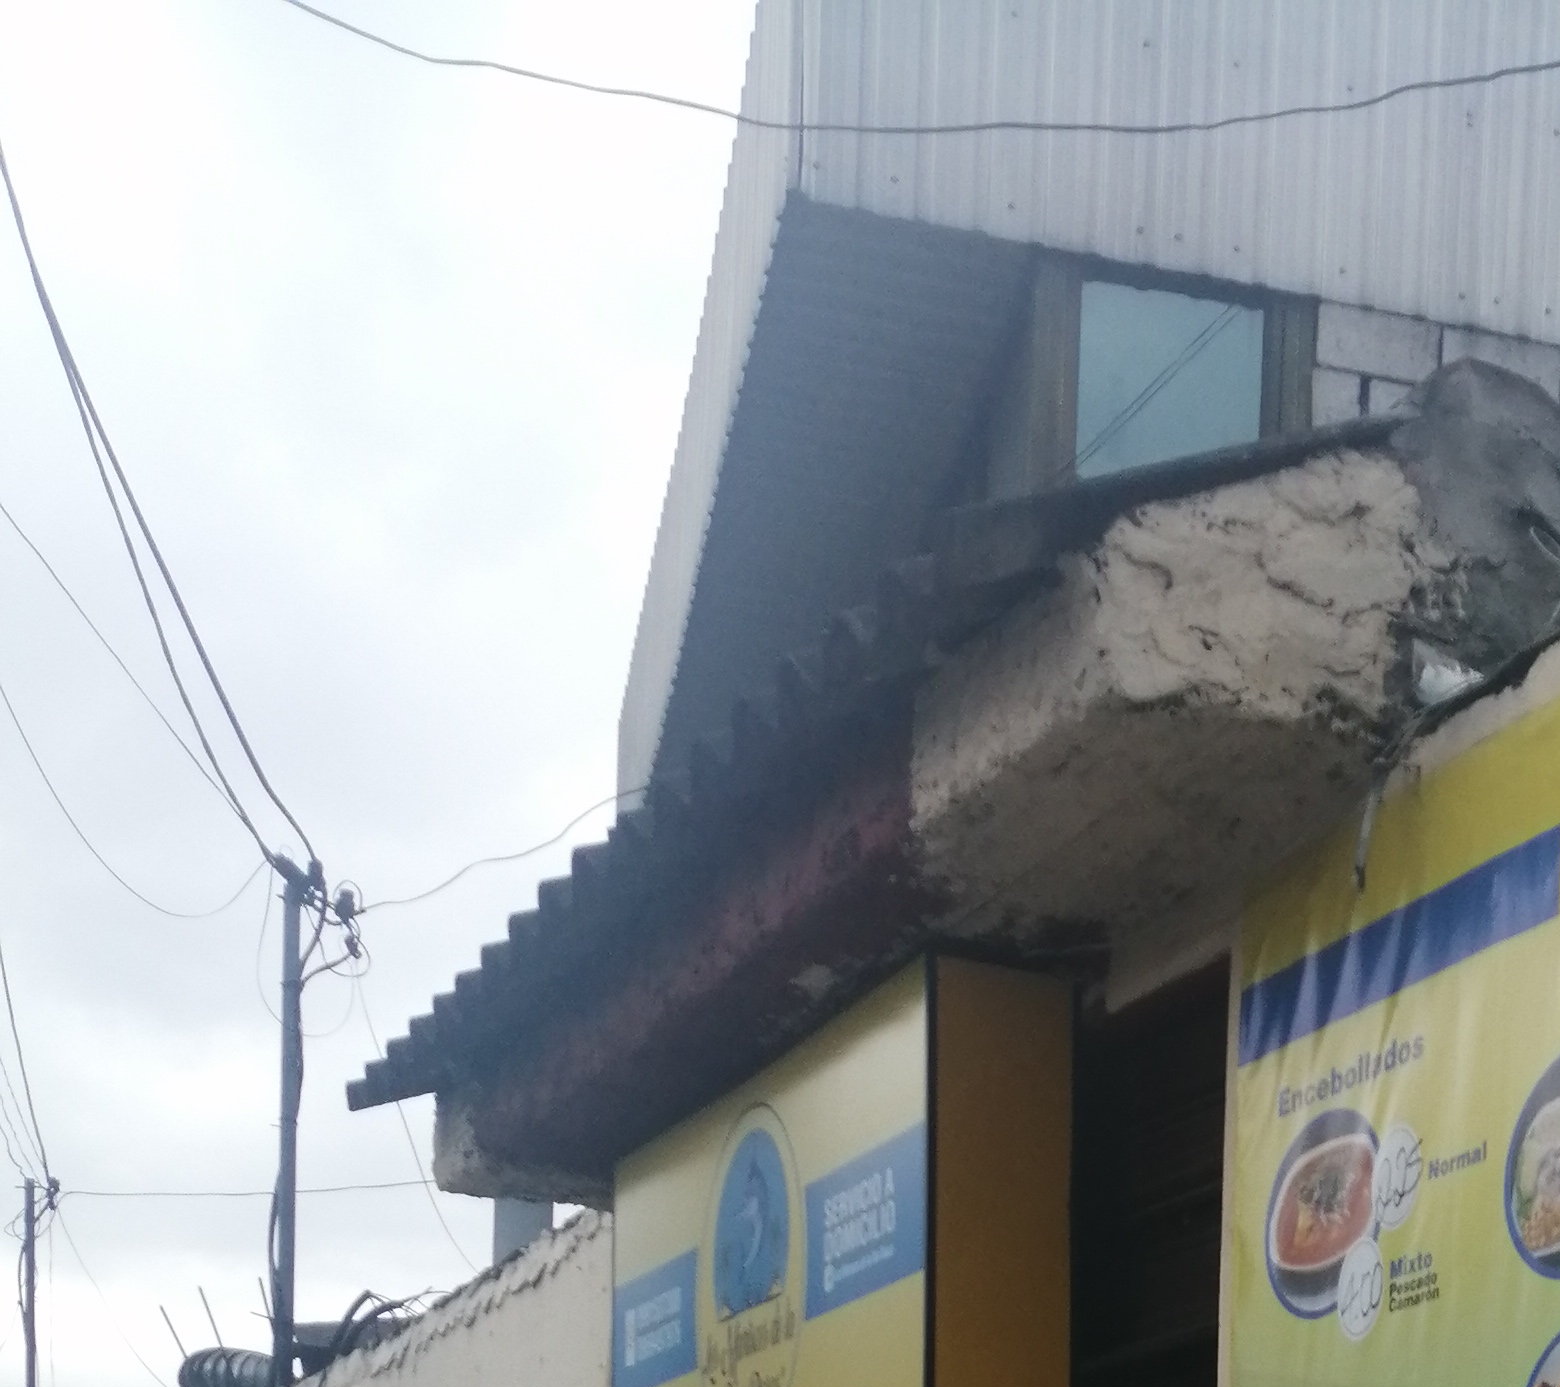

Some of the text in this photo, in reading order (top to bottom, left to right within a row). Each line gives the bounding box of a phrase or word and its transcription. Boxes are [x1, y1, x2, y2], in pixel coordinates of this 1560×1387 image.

[1277, 1034, 1426, 1117] Encebollados
[1427, 1140, 1488, 1180] Normal
[1389, 1251, 1433, 1279] Mixto
[1389, 1271, 1439, 1297] Pescado
